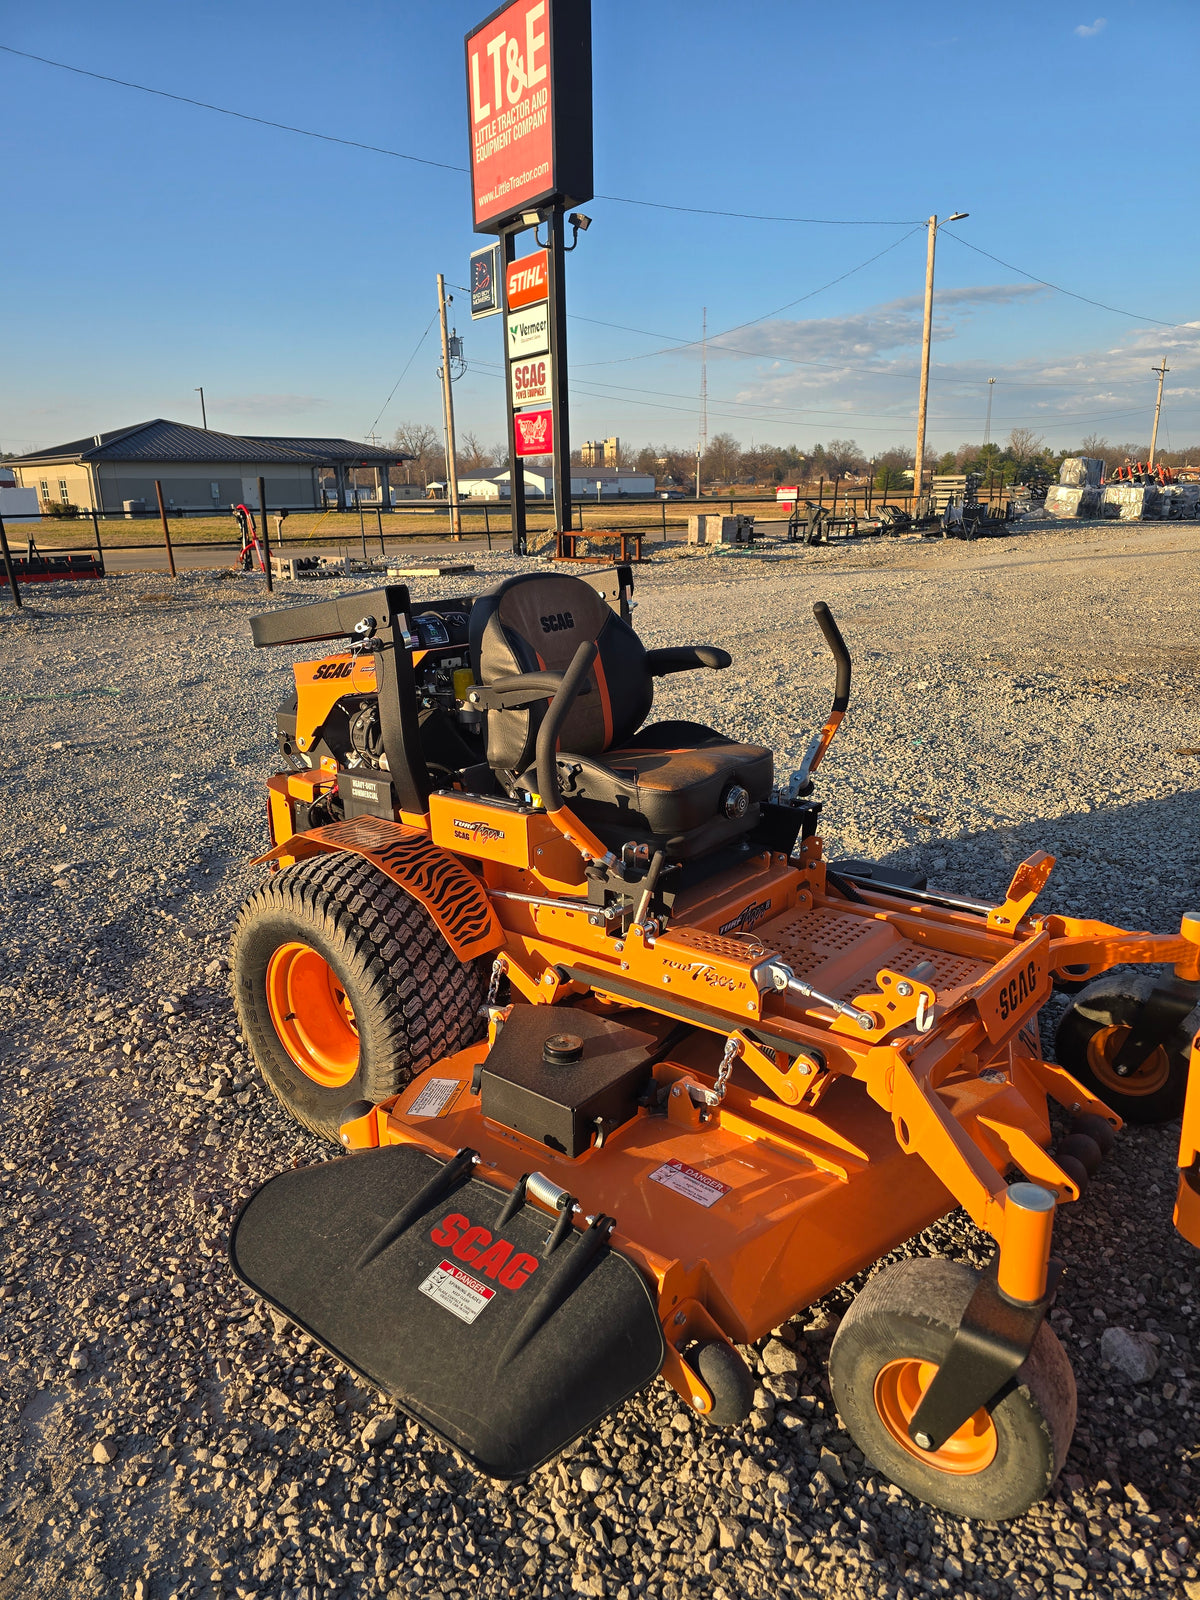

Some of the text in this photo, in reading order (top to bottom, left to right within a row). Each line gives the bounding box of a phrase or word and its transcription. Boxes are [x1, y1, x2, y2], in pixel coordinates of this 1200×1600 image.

[472, 1, 547, 124] LT&E
[475, 87, 547, 147] LITTLE TRACTOR AND
[476, 107, 547, 163] EQUIPMENT COMPANY
[478, 161, 549, 207] www.LittleTractor.com
[509, 271, 544, 294] STIHL
[519, 320, 546, 336] Vermeer
[515, 362, 545, 389] SCAG
[540, 611, 574, 633] SCAG
[313, 662, 356, 680] SCAG
[454, 819, 475, 830] TURF
[454, 830, 470, 840] SCAG
[691, 962, 737, 991] Tiger
[999, 961, 1036, 1020] SCAG
[685, 1168, 724, 1191] DANGER
[431, 1213, 539, 1290] SCAG
[455, 1271, 485, 1294] DANGER
